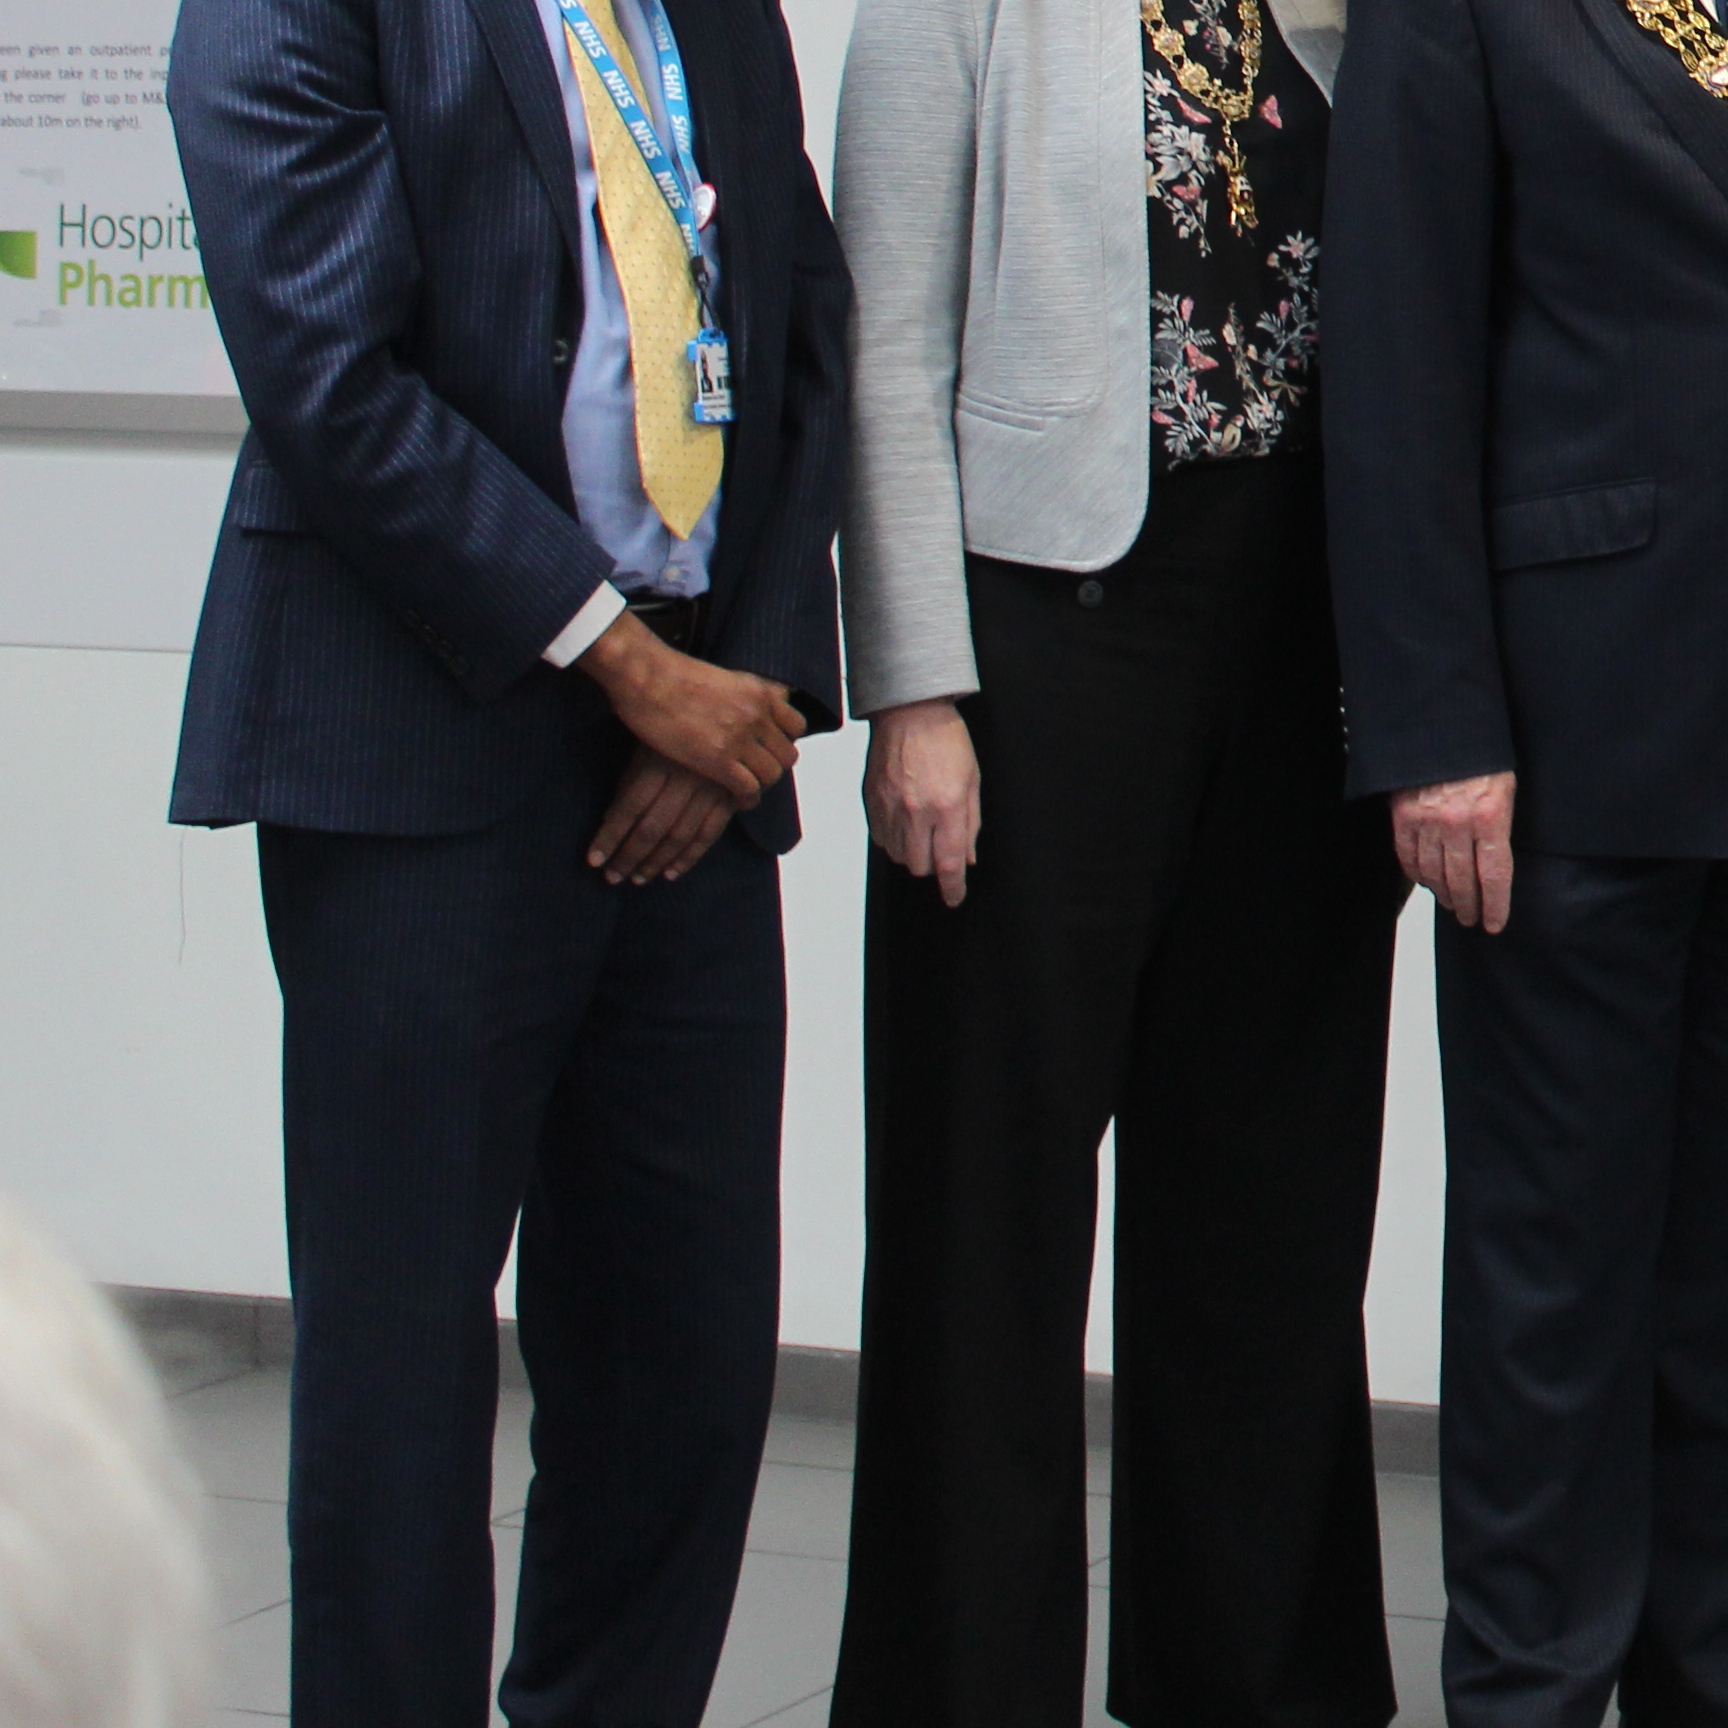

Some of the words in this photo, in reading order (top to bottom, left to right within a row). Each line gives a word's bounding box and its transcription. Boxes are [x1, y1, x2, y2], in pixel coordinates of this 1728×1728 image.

[28, 45, 60, 58] given
[67, 46, 82, 55] an
[89, 45, 152, 57] outpatient
[58, 68, 83, 80] take
[105, 69, 118, 80] to
[123, 69, 143, 80] the
[603, 69, 636, 109] NHS
[662, 63, 684, 101] NHS
[59, 202, 200, 261] Hospit
[59, 259, 209, 307] Pharm
